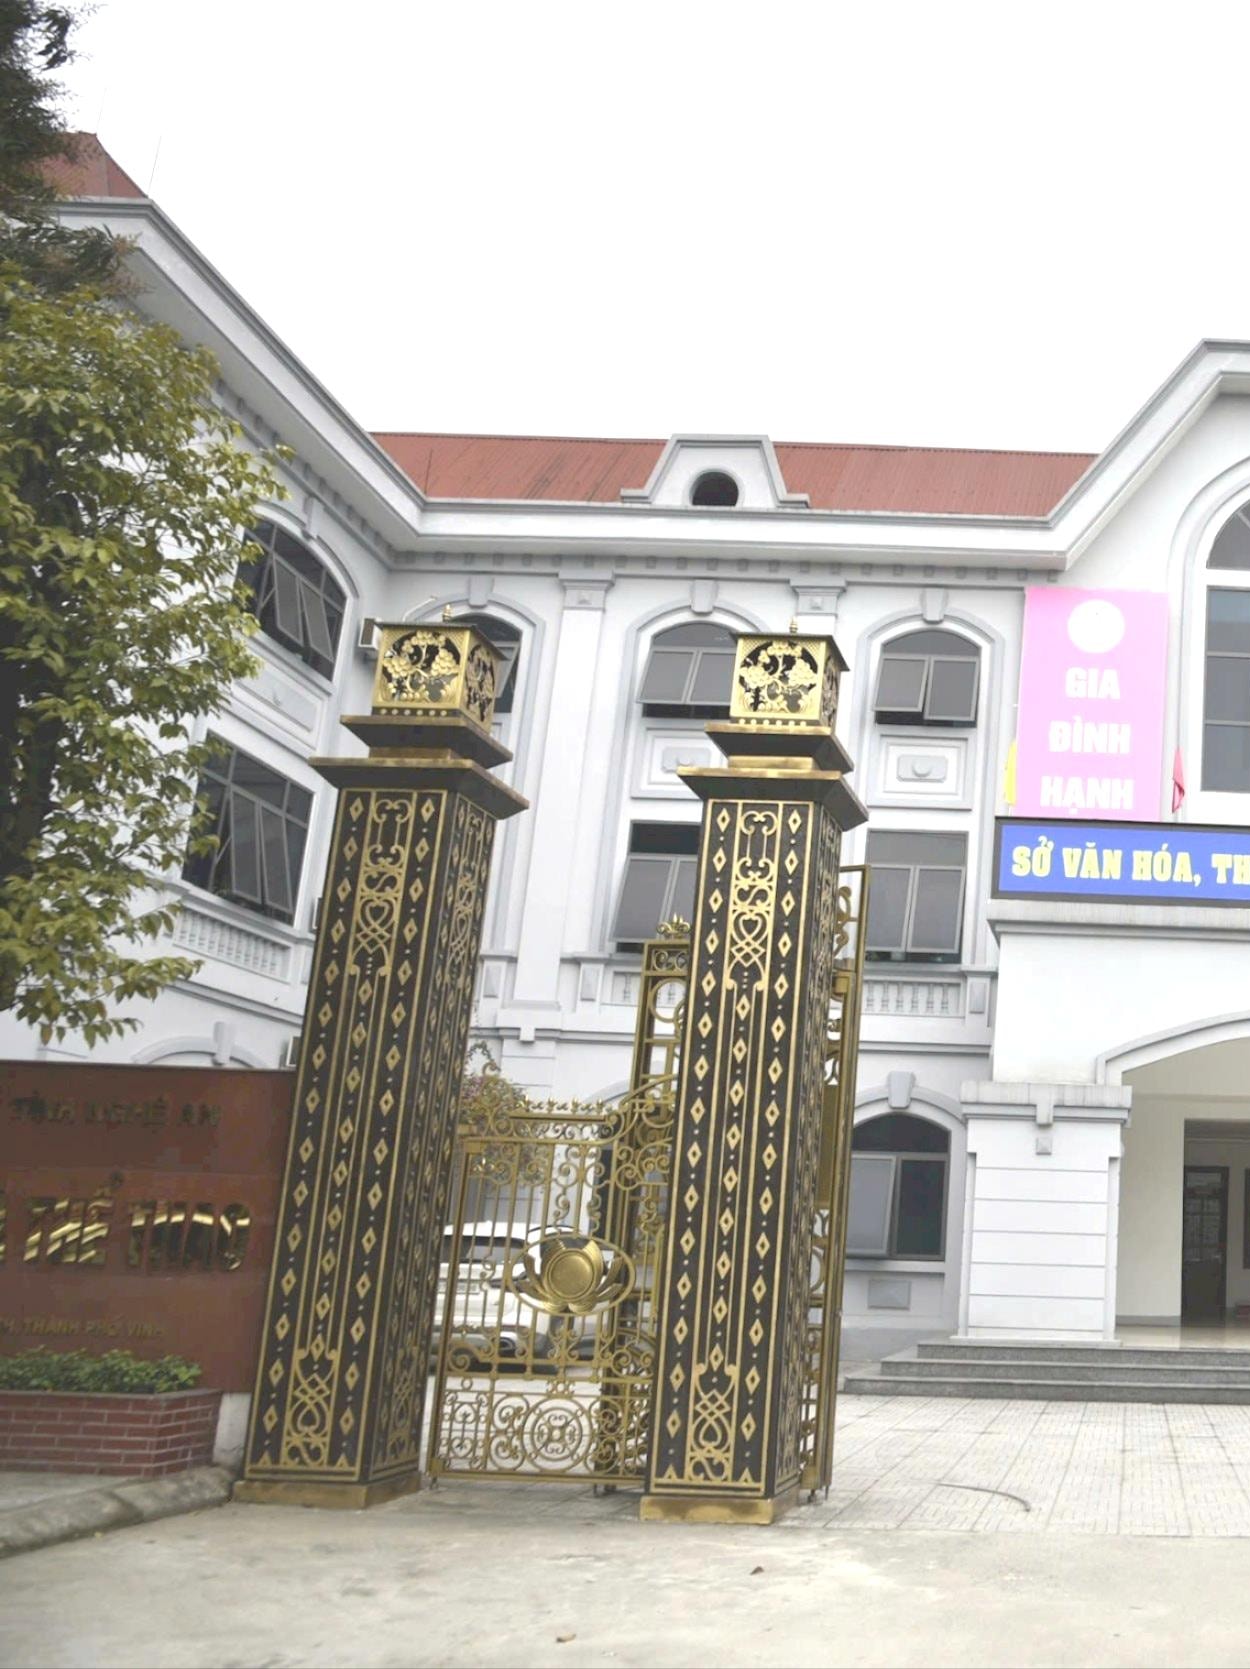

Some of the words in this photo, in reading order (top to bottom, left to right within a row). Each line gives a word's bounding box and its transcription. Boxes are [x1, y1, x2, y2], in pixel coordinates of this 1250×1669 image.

[1065, 667, 1121, 700] GIA
[1048, 714, 1132, 754] ĐÌNH
[1040, 775, 1135, 815] HẠNH
[1011, 835, 1054, 878] SỞ
[1062, 841, 1122, 880] VĂN
[1131, 843, 1201, 887] HÓA,
